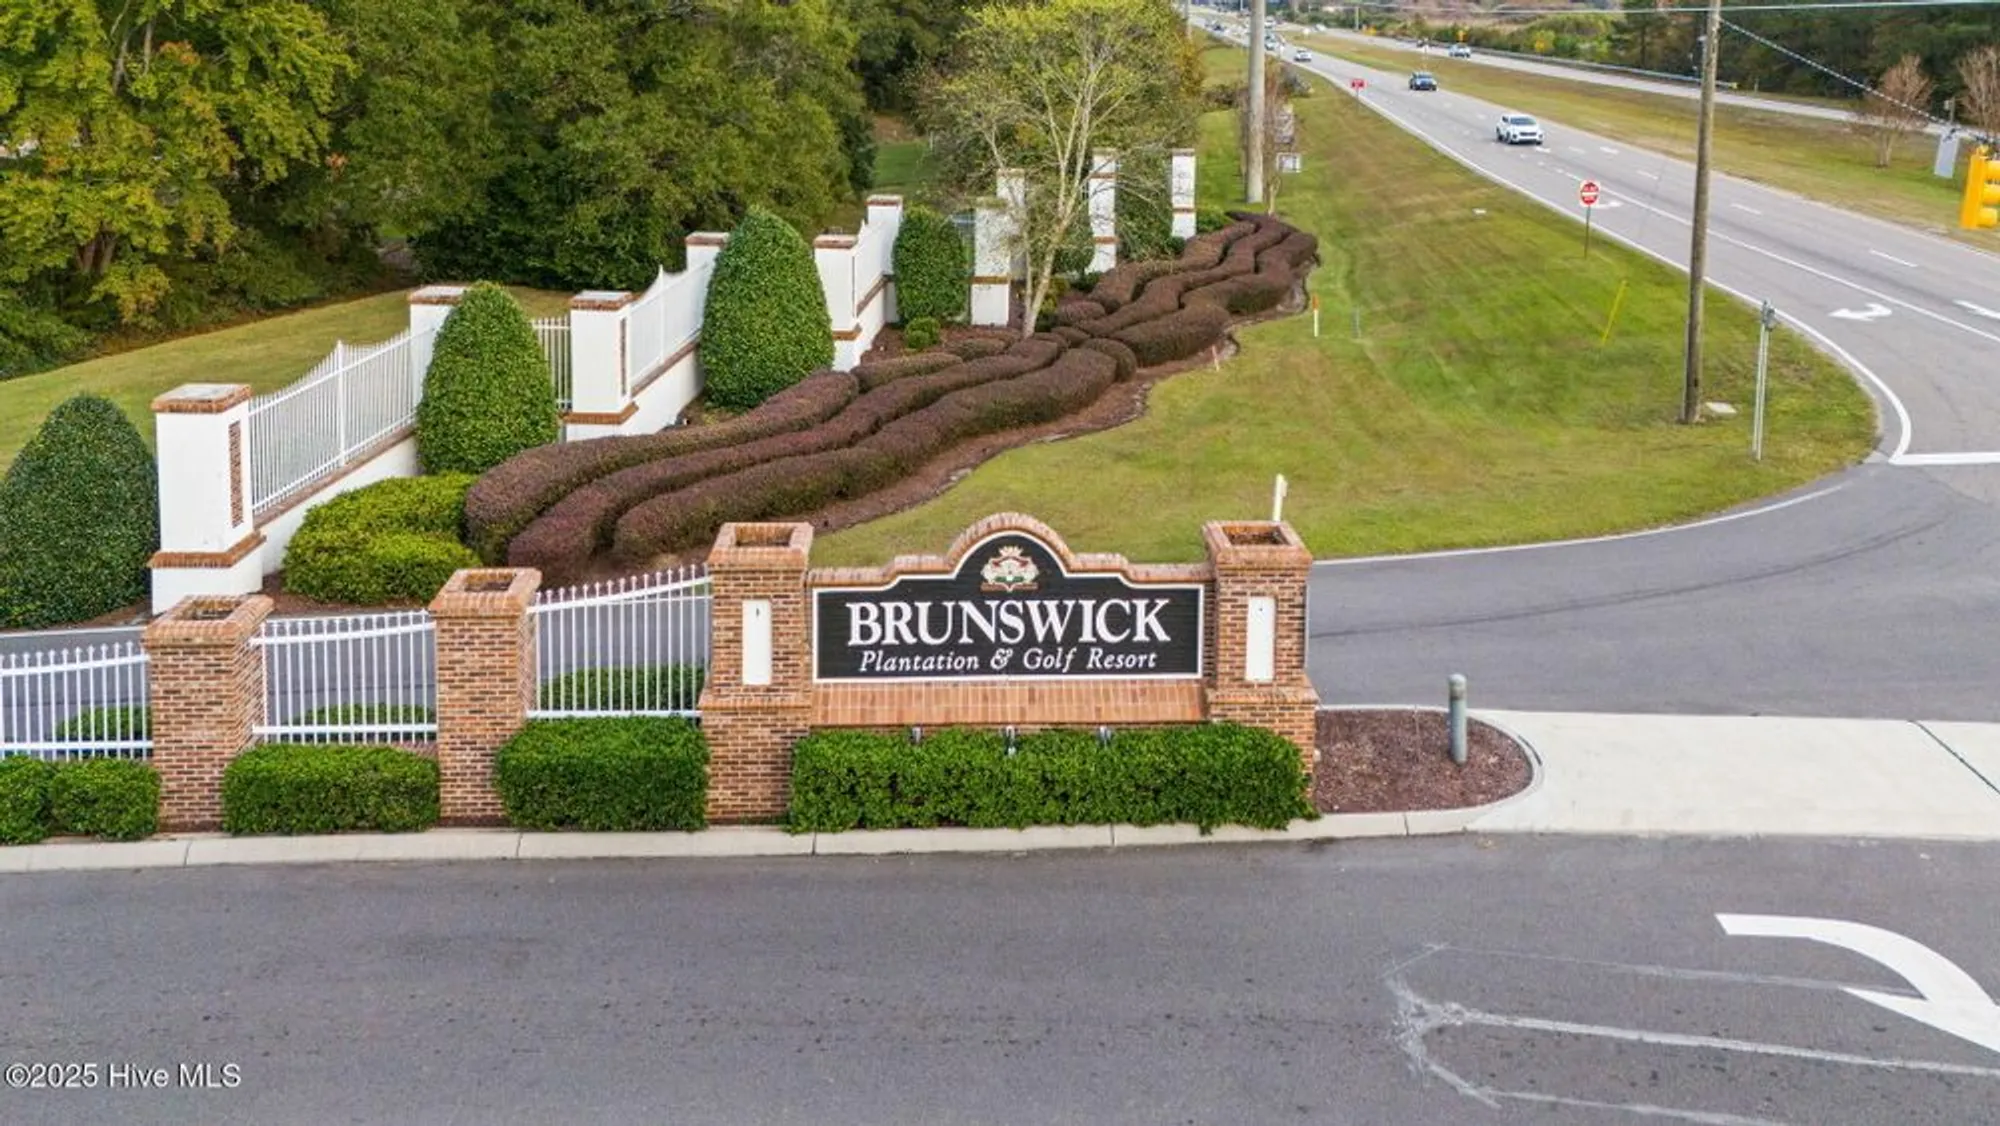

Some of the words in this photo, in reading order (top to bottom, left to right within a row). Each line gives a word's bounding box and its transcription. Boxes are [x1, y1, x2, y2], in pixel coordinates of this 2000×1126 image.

[845, 598, 1171, 646] BRUNSWICK
[858, 649, 980, 673] Plantation
[989, 647, 1013, 671] &
[1022, 646, 1078, 674] Golf
[1086, 645, 1158, 671] Resort
